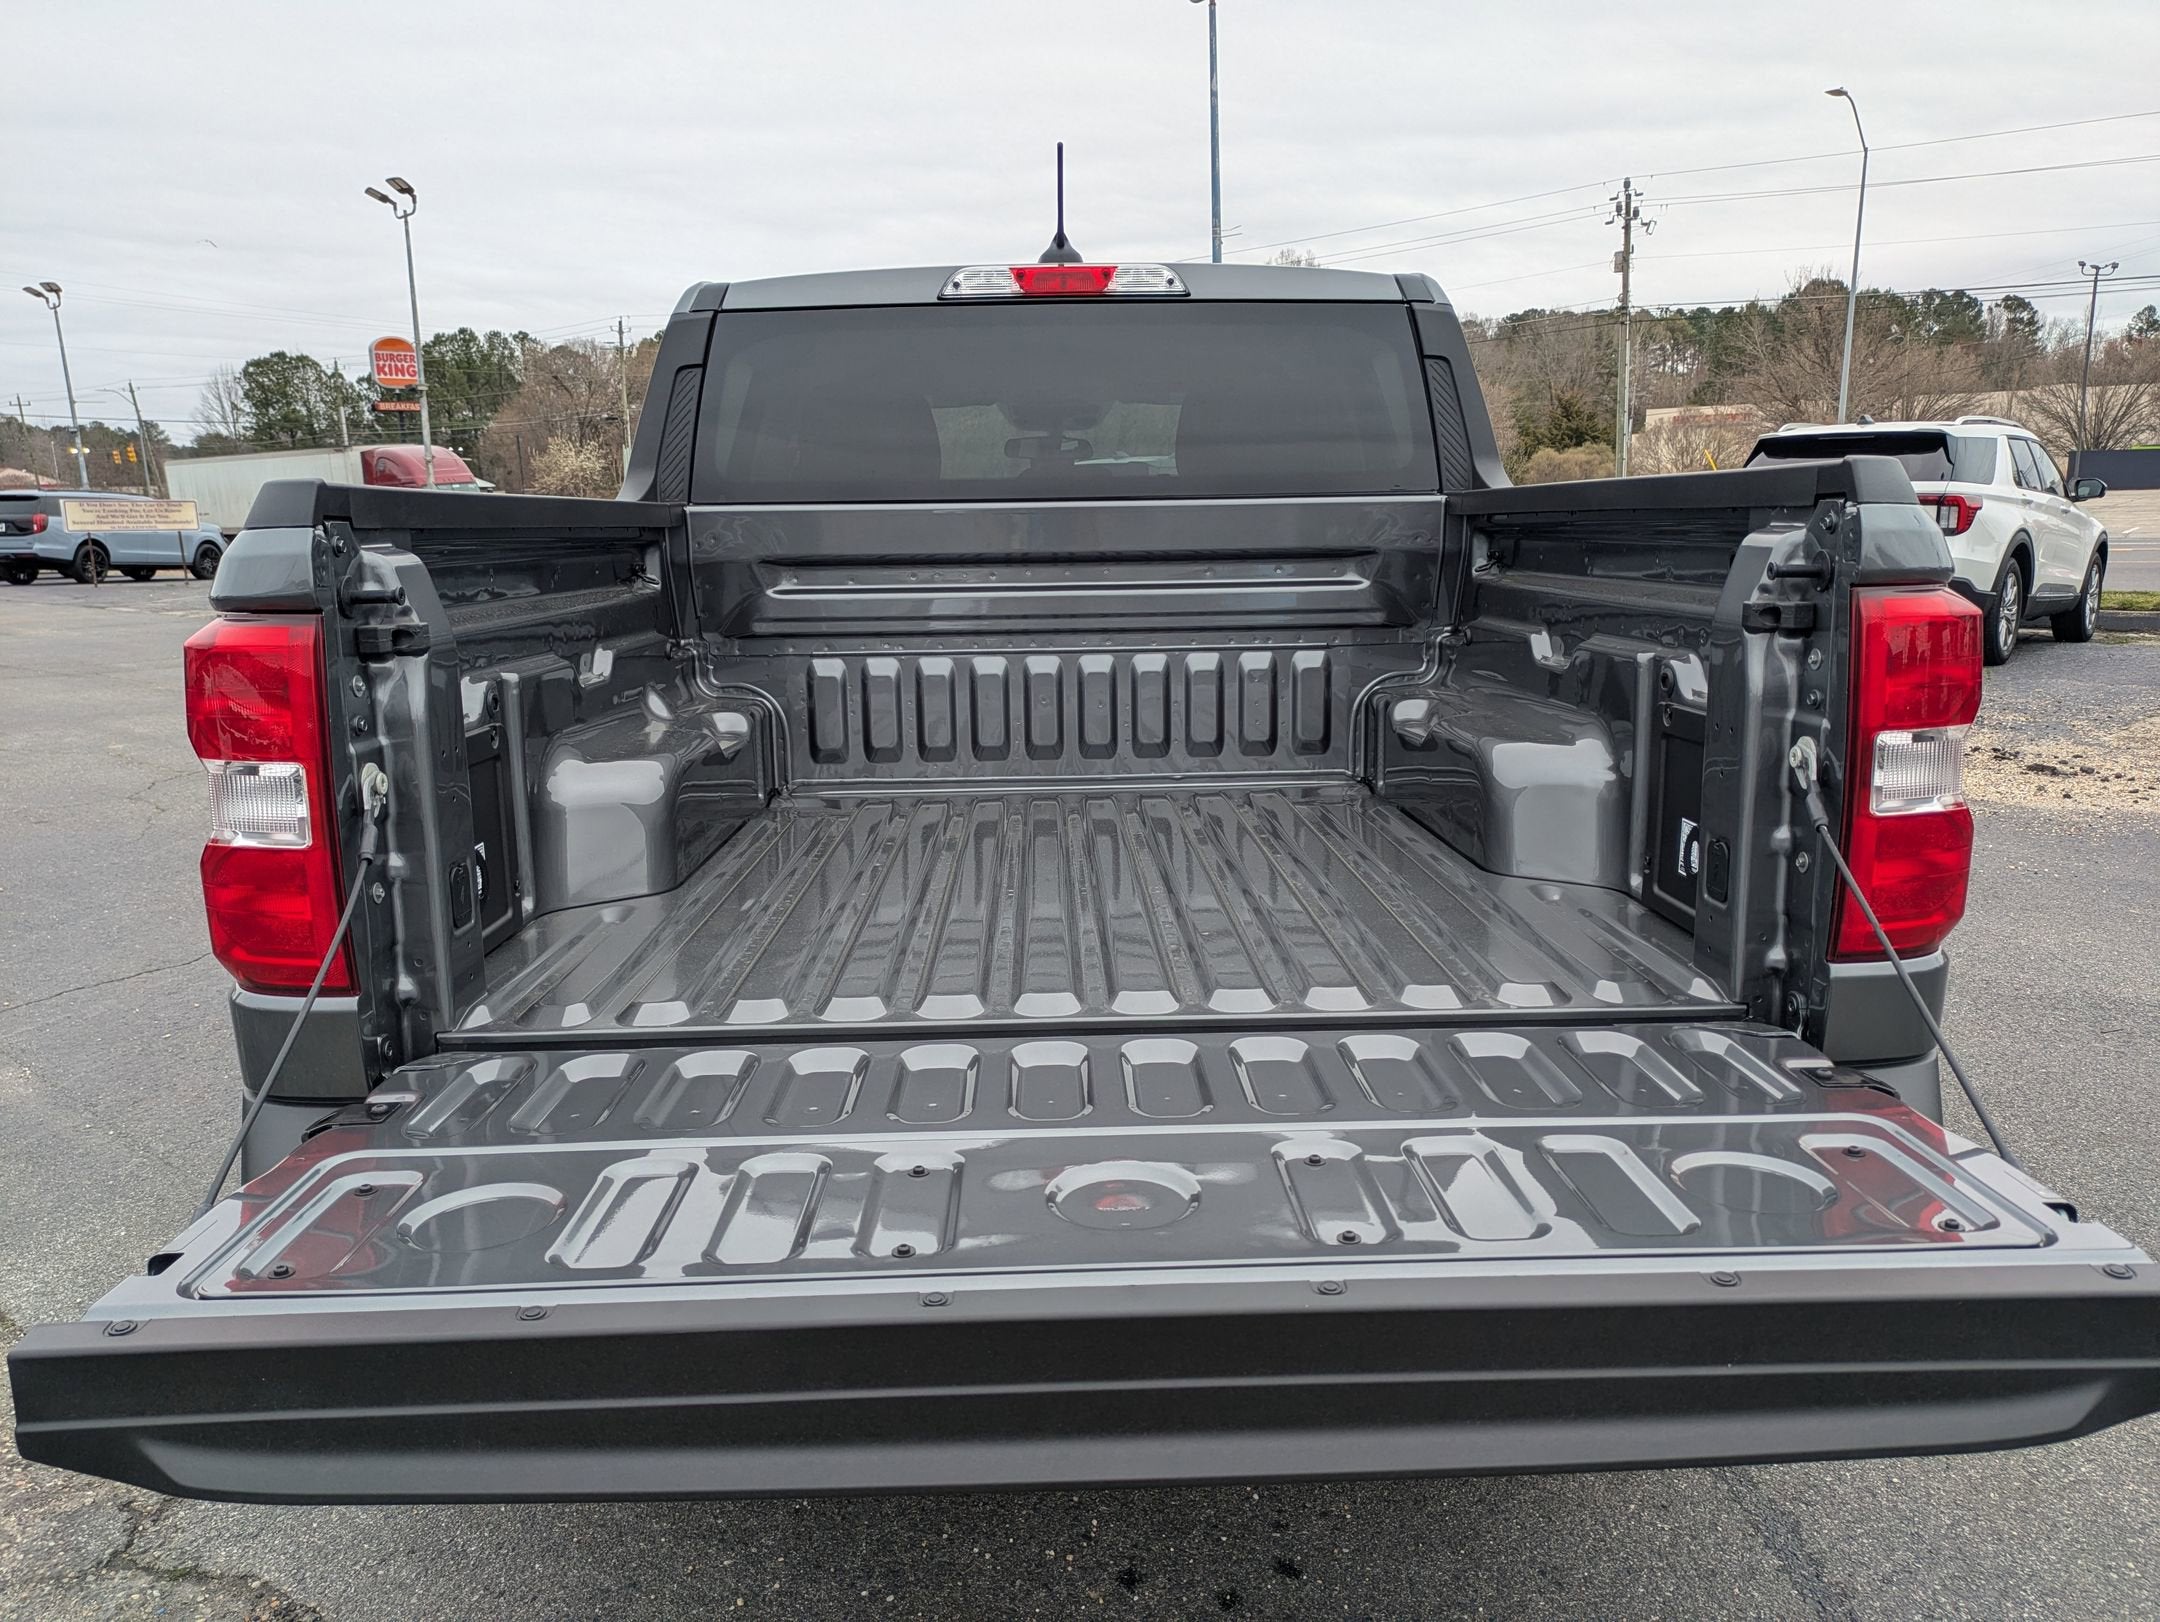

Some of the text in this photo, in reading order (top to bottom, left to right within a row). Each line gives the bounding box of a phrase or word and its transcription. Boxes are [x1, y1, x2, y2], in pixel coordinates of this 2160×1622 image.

[375, 353, 416, 363] BURGER
[376, 363, 417, 377] KING
[381, 402, 421, 411] BREAKFAS
